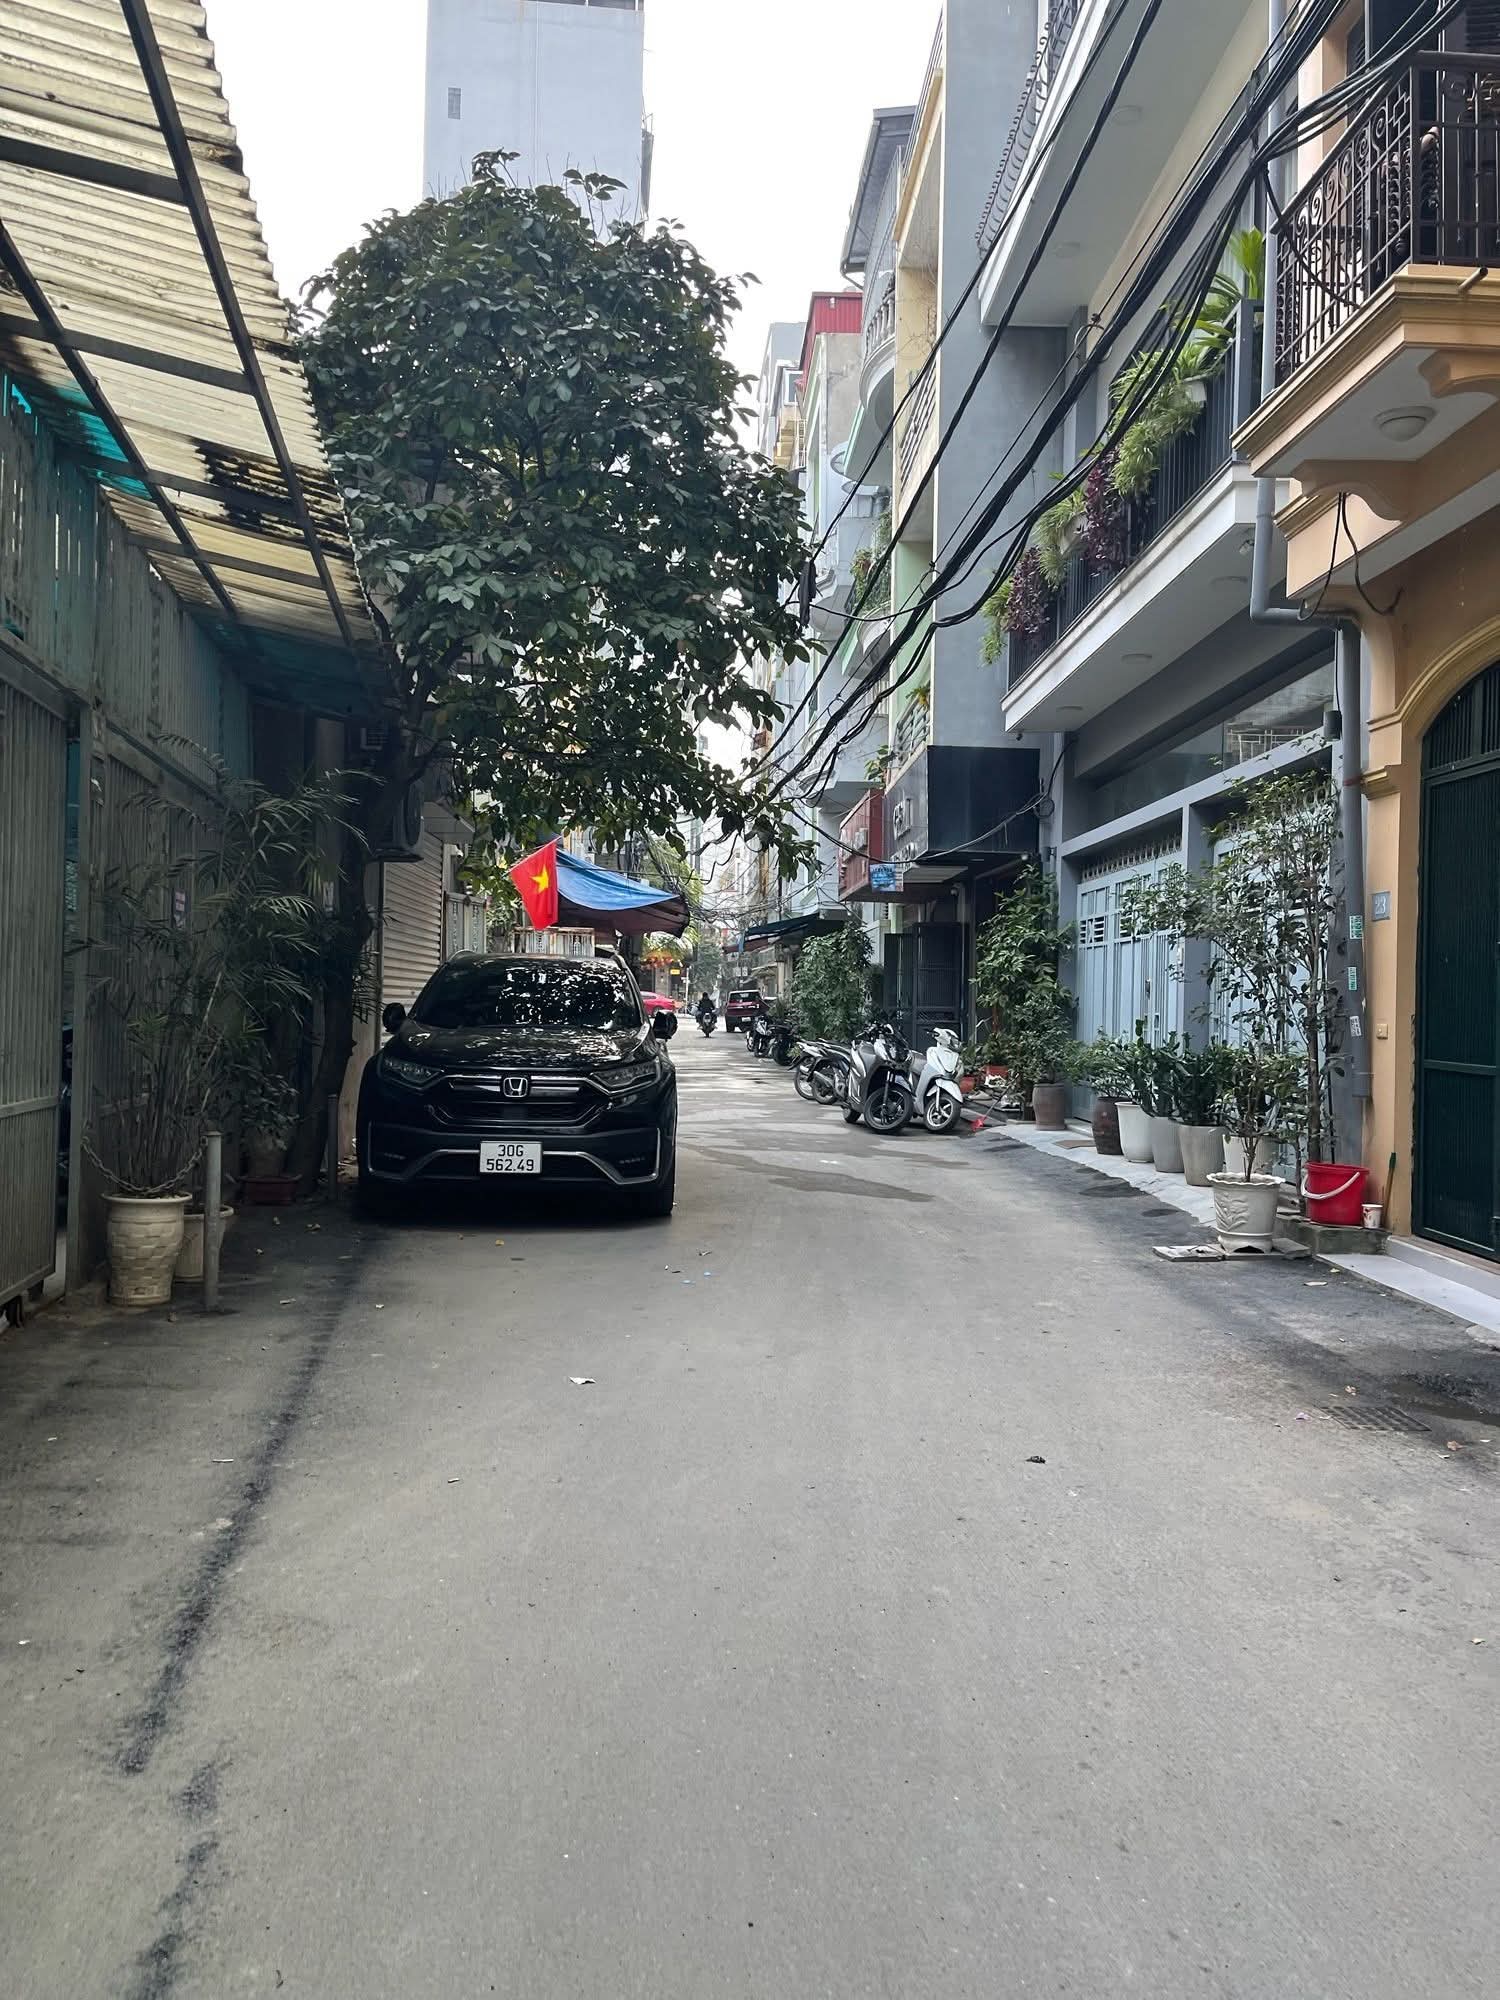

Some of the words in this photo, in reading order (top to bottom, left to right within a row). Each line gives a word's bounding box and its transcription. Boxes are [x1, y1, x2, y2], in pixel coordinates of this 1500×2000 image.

[1375, 895, 1387, 915] 23
[497, 1144, 524, 1157] 30G
[486, 1158, 534, 1172] 562.49
